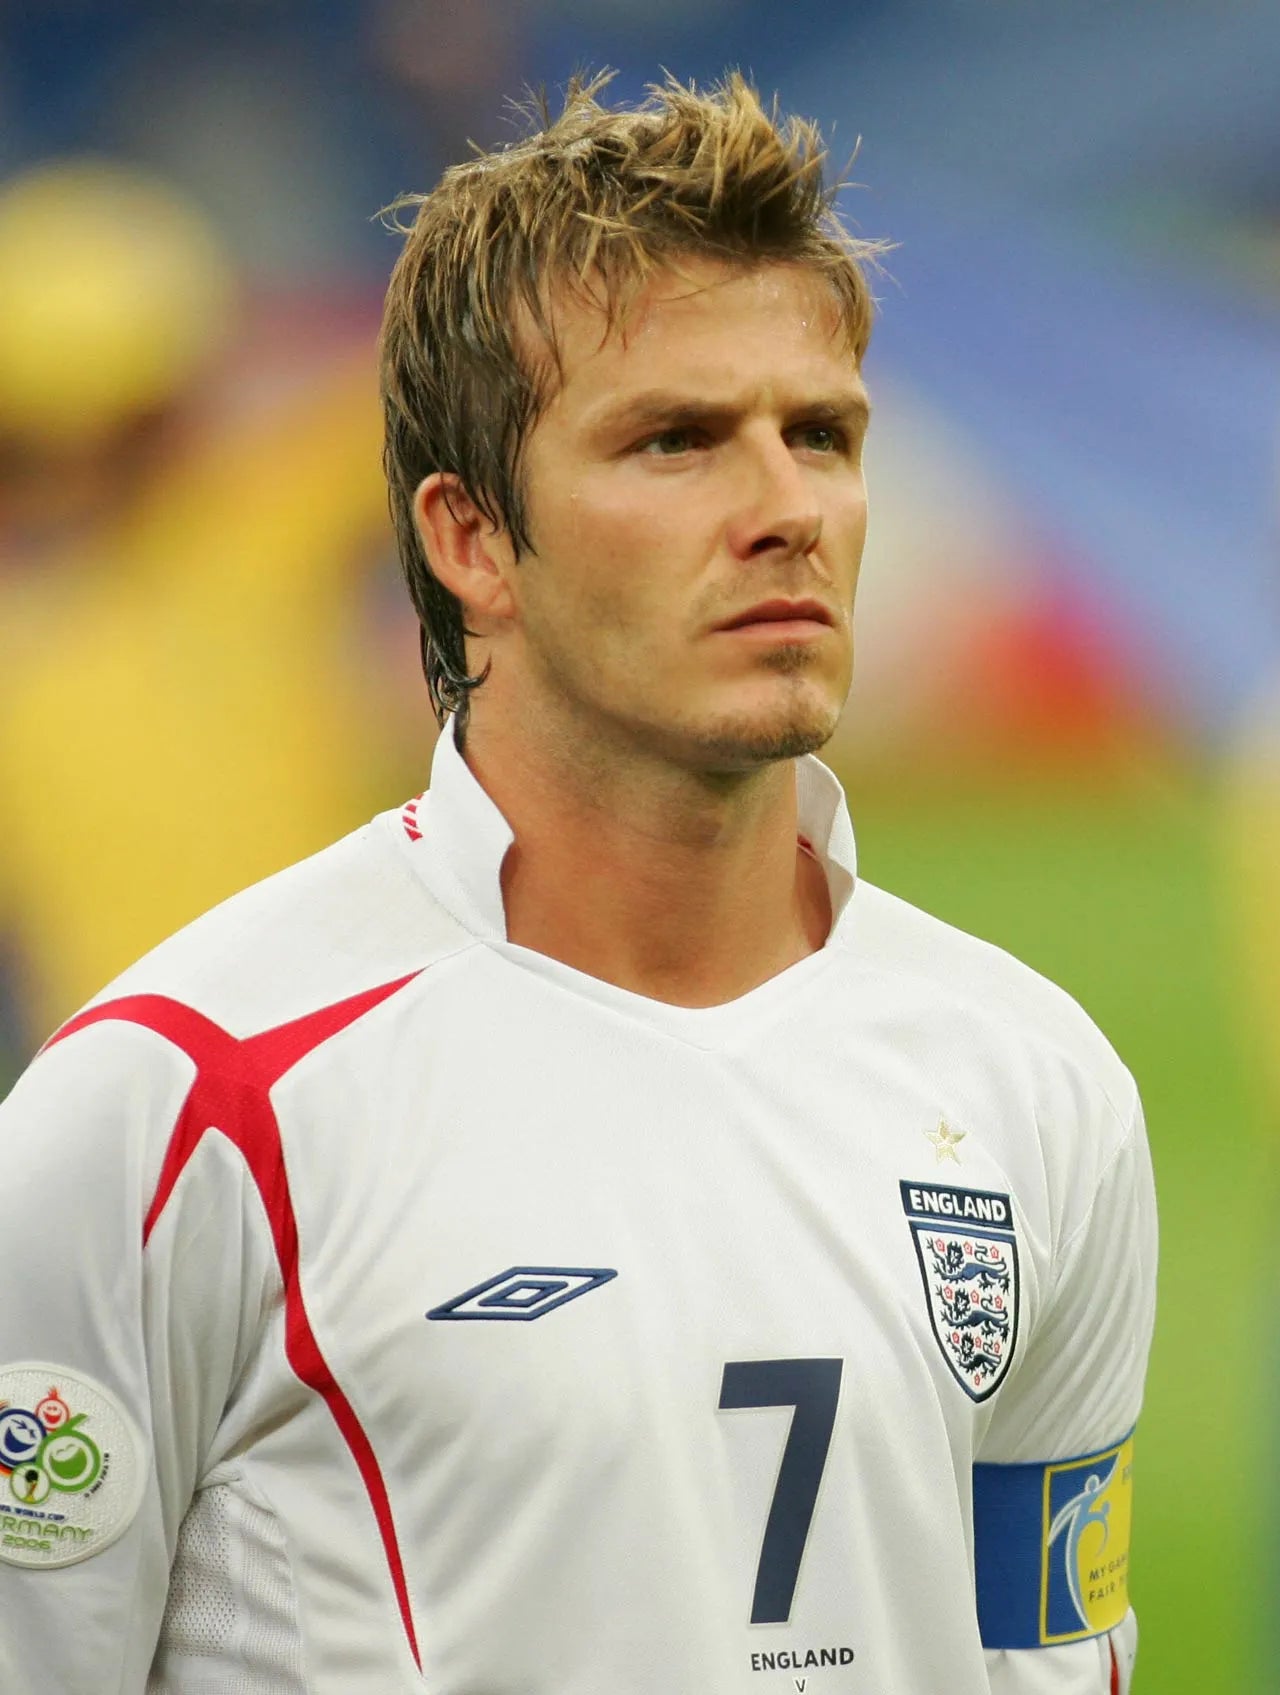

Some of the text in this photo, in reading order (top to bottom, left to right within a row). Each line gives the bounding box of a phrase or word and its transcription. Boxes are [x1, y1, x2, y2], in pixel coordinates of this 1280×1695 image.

[909, 1188, 1007, 1222] ENGLAND
[717, 1357, 844, 1625] 7
[2, 1534, 51, 1551] 2006
[1088, 1563, 1107, 1583] MY
[1088, 1580, 1116, 1603] FAIR
[751, 1647, 854, 1671] ENGLAND
